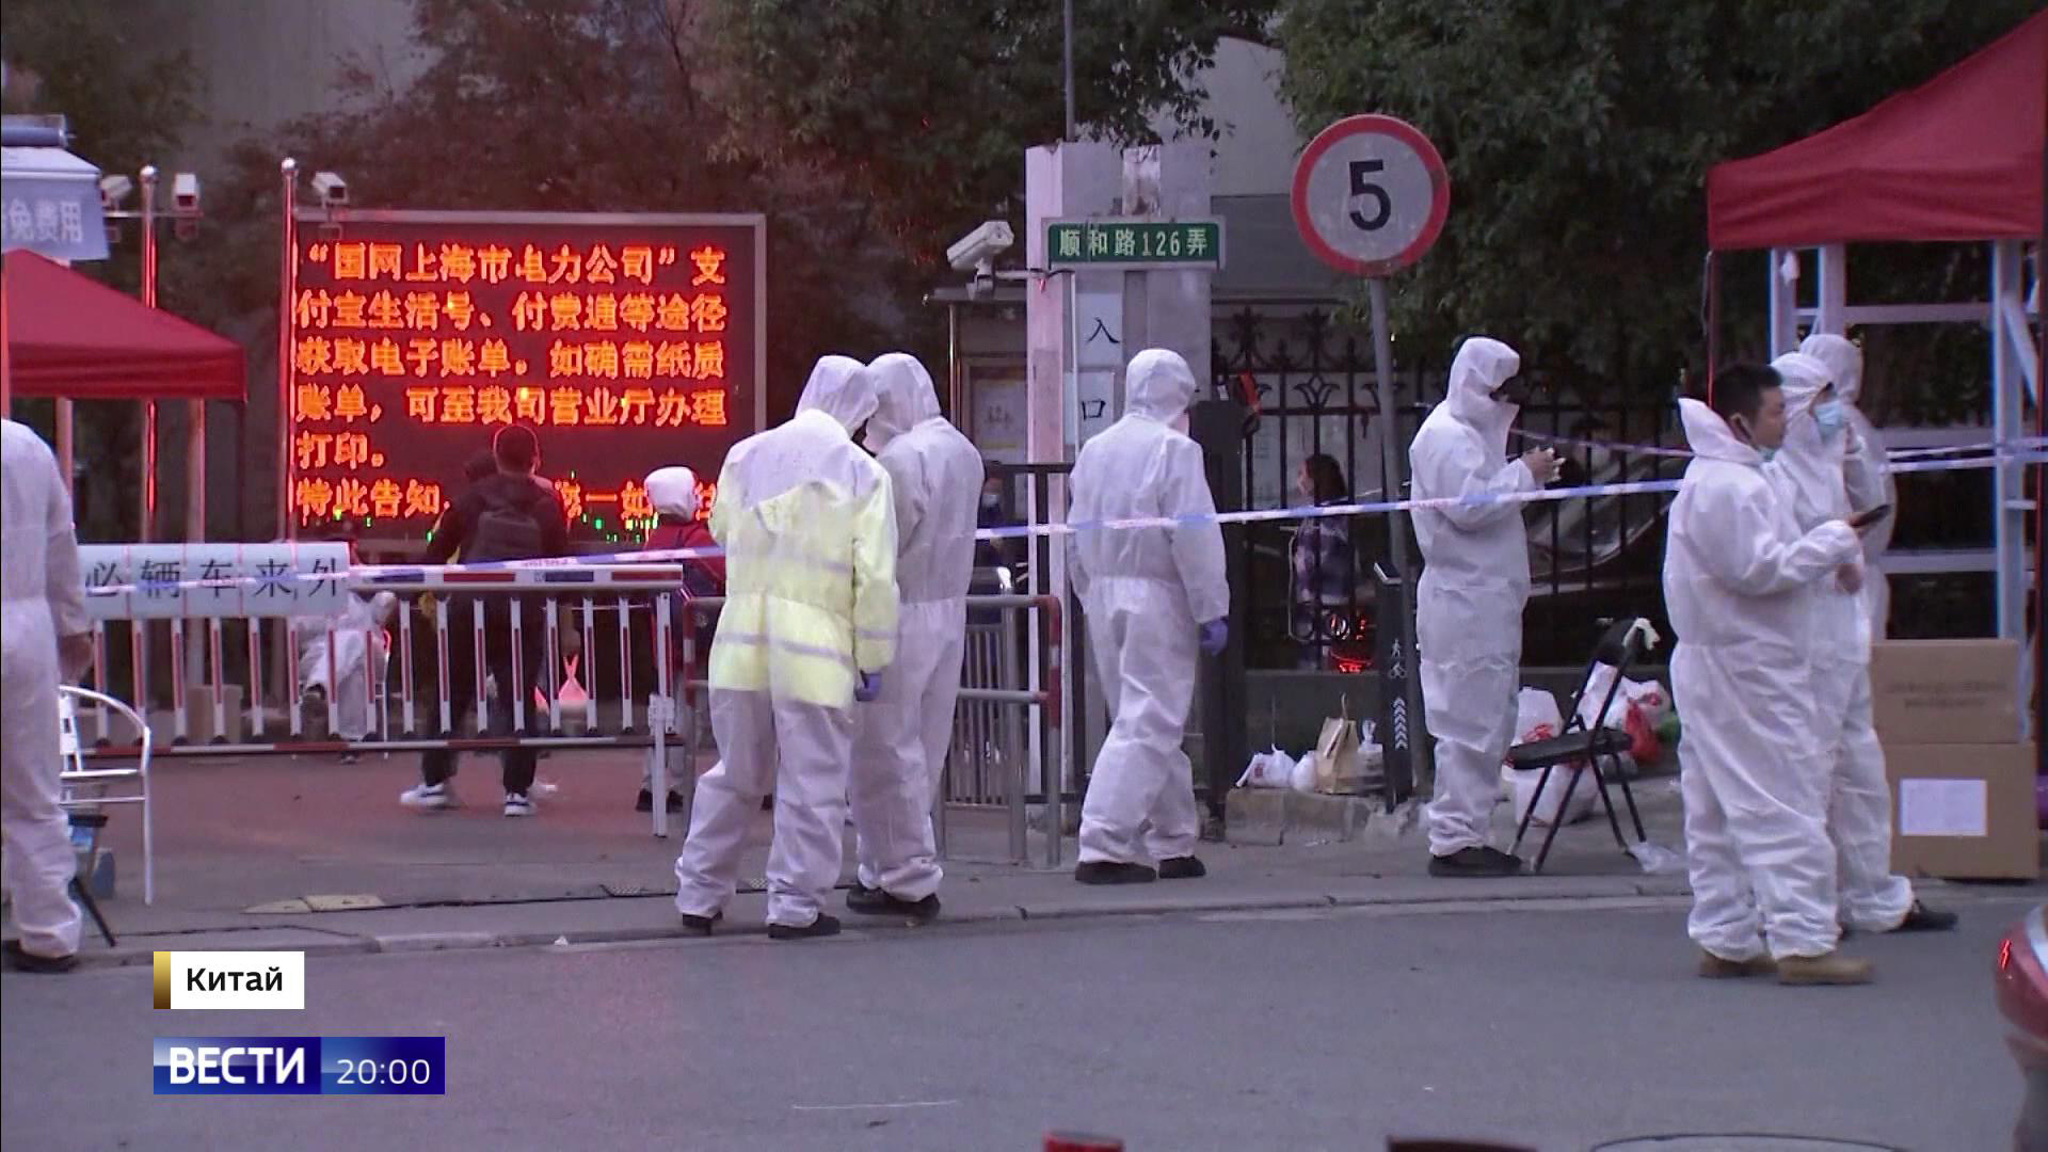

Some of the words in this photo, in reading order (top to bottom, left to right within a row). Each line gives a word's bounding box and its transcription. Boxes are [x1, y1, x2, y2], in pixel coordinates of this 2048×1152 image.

[1349, 159, 1392, 232] 5
[1059, 227, 1208, 257] 顺和路126弄
[297, 336, 725, 379] 获取电子账单。如确需纸质
[296, 430, 385, 470] 打印。
